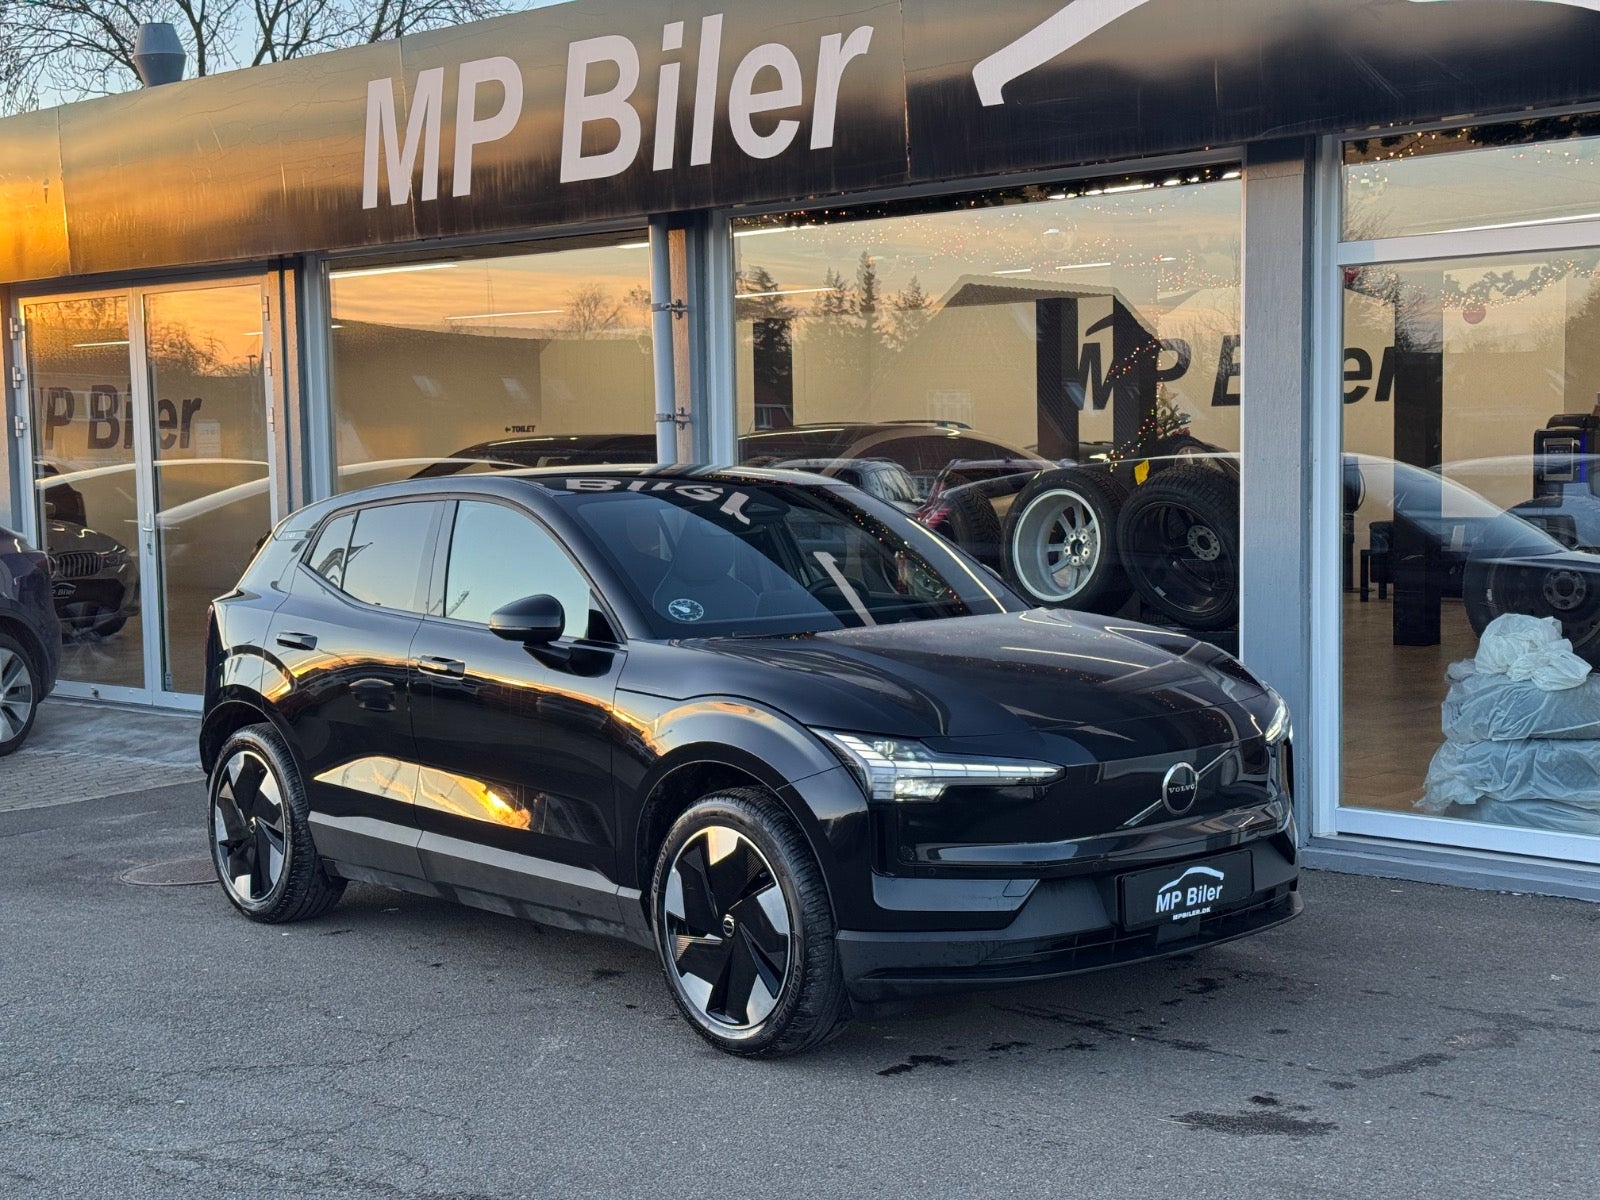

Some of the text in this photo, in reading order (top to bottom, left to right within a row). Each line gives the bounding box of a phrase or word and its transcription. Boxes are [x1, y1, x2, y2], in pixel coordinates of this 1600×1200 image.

[362, 13, 874, 210] MP Biler
[511, 425, 536, 433] TOILET
[1168, 783, 1195, 794] VOLVO
[1155, 884, 1223, 913] MP Biler
[1172, 906, 1211, 921] MPBILER.DK
